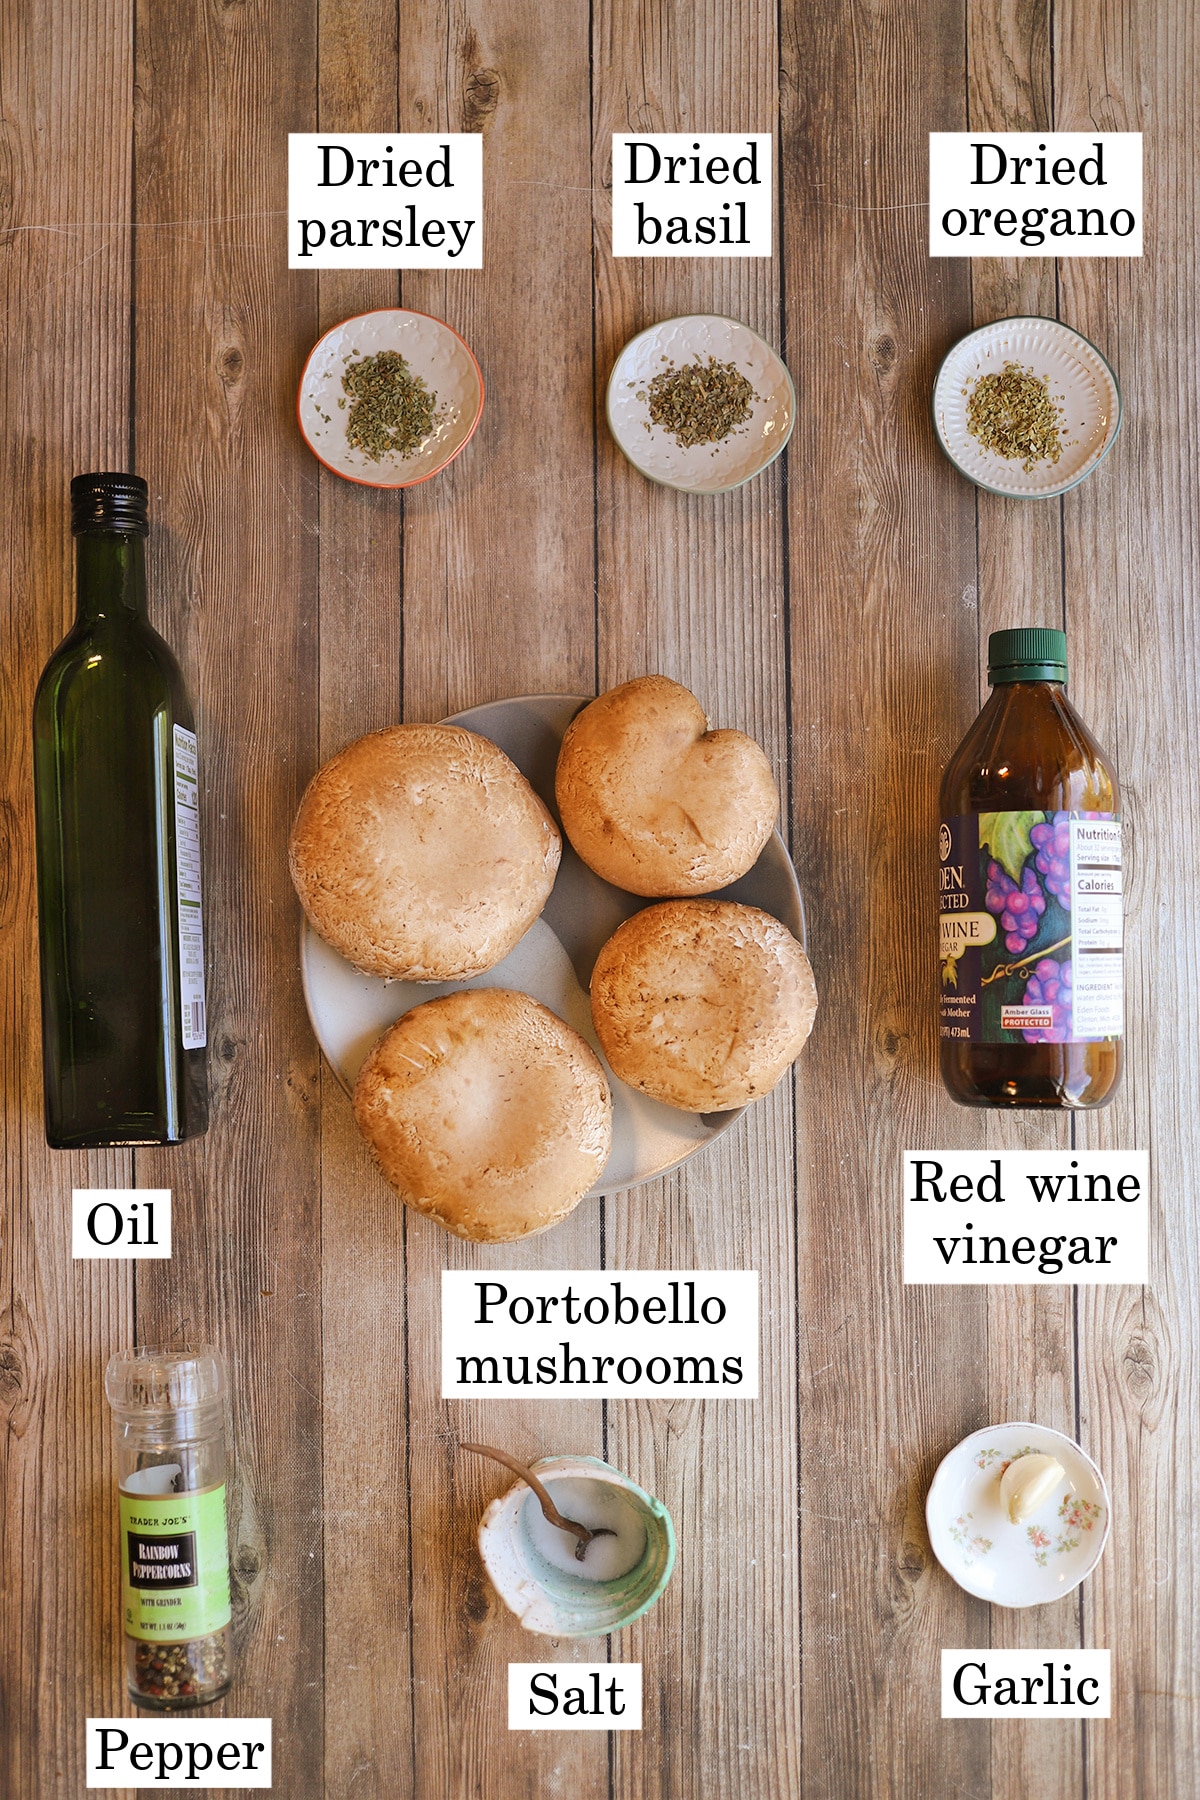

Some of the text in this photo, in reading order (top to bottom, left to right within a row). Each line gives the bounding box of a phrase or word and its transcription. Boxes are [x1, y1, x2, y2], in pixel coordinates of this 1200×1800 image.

[1078, 879, 1114, 891] Calories
[942, 921, 980, 938] WINE
[1004, 1018, 1050, 1026] PROTECTED
[130, 1516, 188, 1526] TRADER JOE'S
[138, 1543, 180, 1560] RAINBOW
[132, 1561, 192, 1579] PEPPERCORNS
